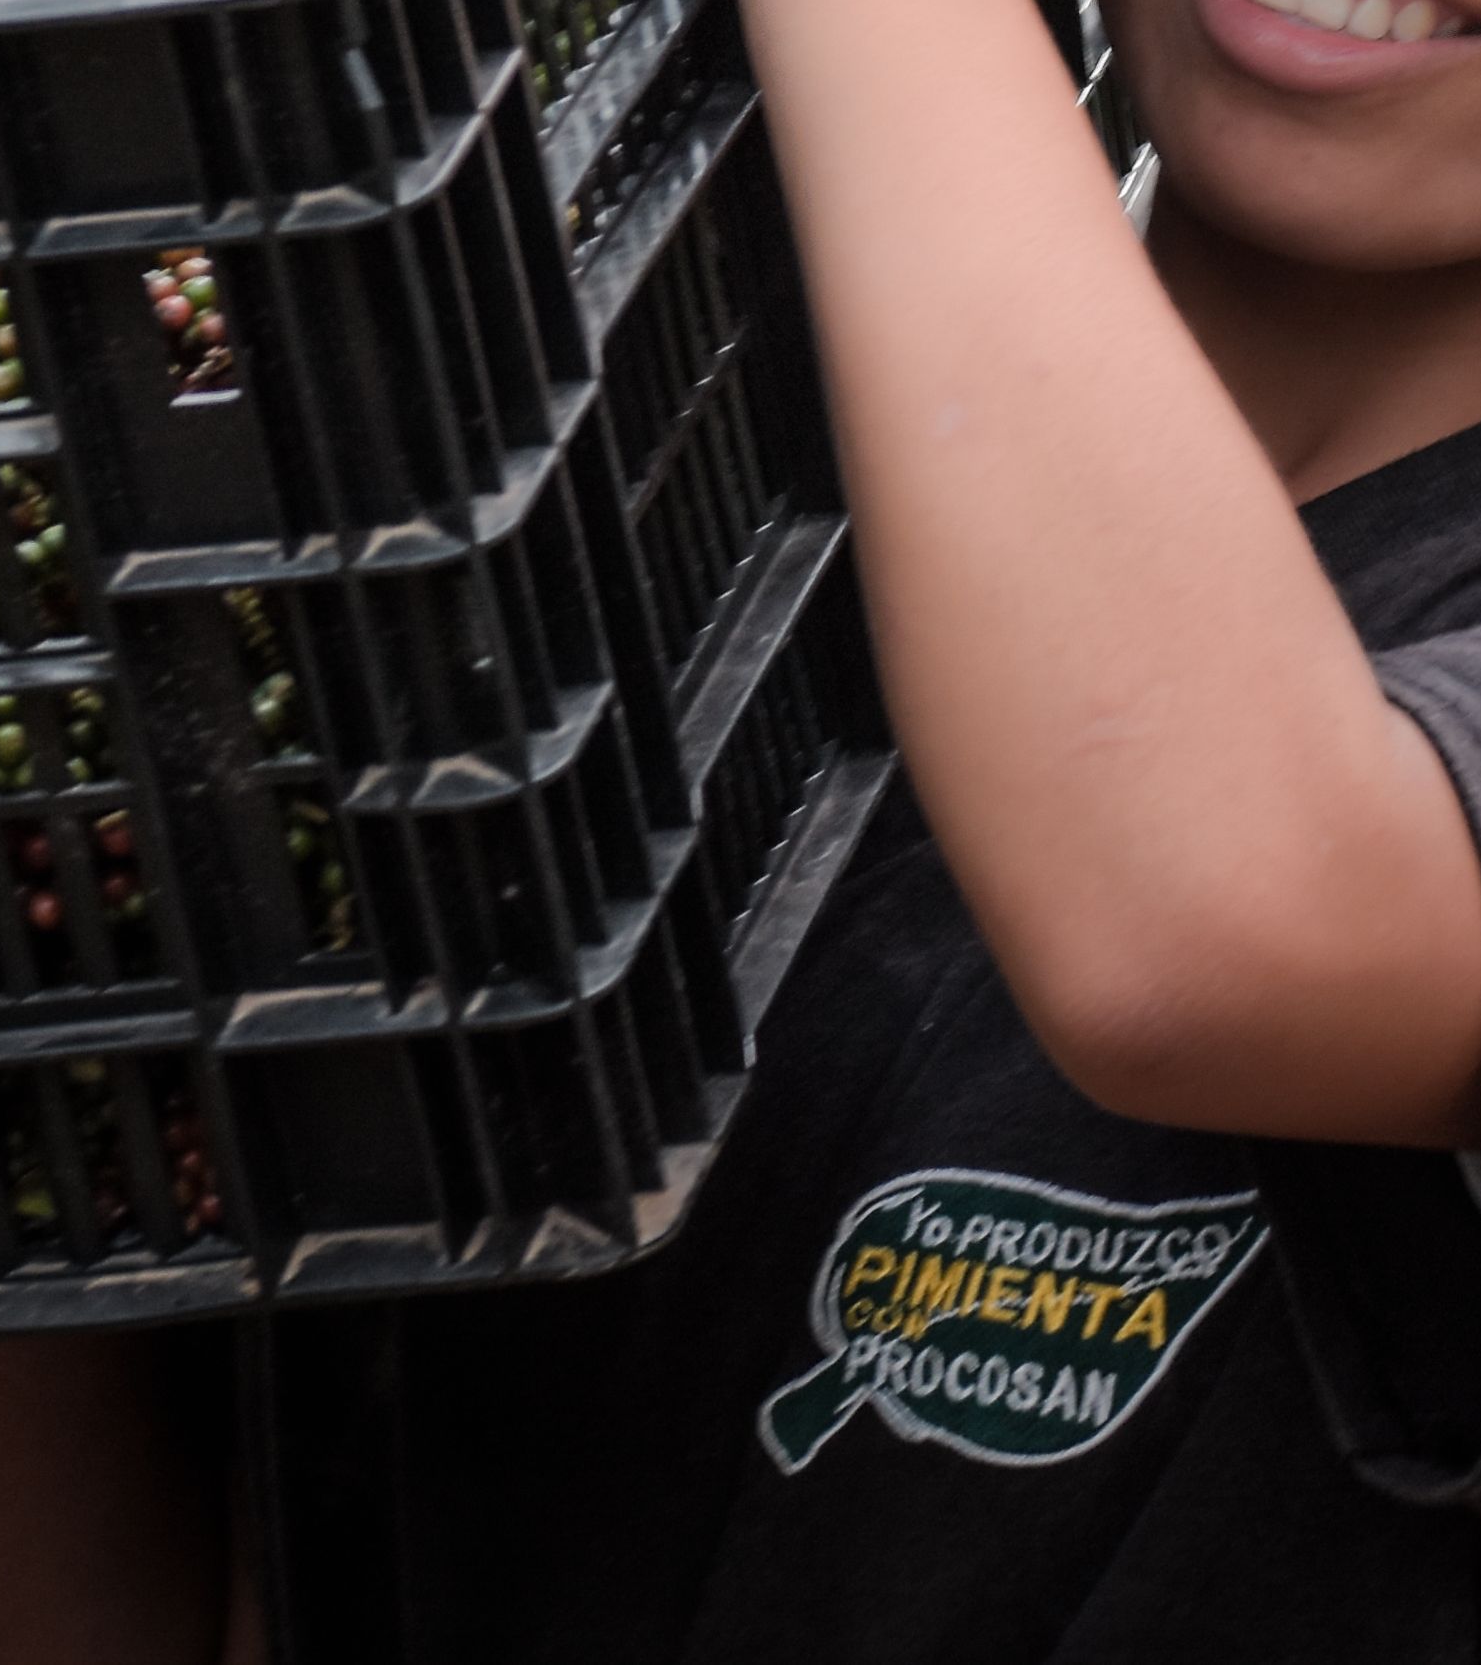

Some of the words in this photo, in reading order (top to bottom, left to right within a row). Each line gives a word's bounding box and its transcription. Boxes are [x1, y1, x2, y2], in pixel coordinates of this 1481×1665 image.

[955, 1214, 1227, 1277] PRODUZCO
[843, 1245, 1167, 1351] PIMIENTA
[842, 1334, 1118, 1427] PROCOSAN
